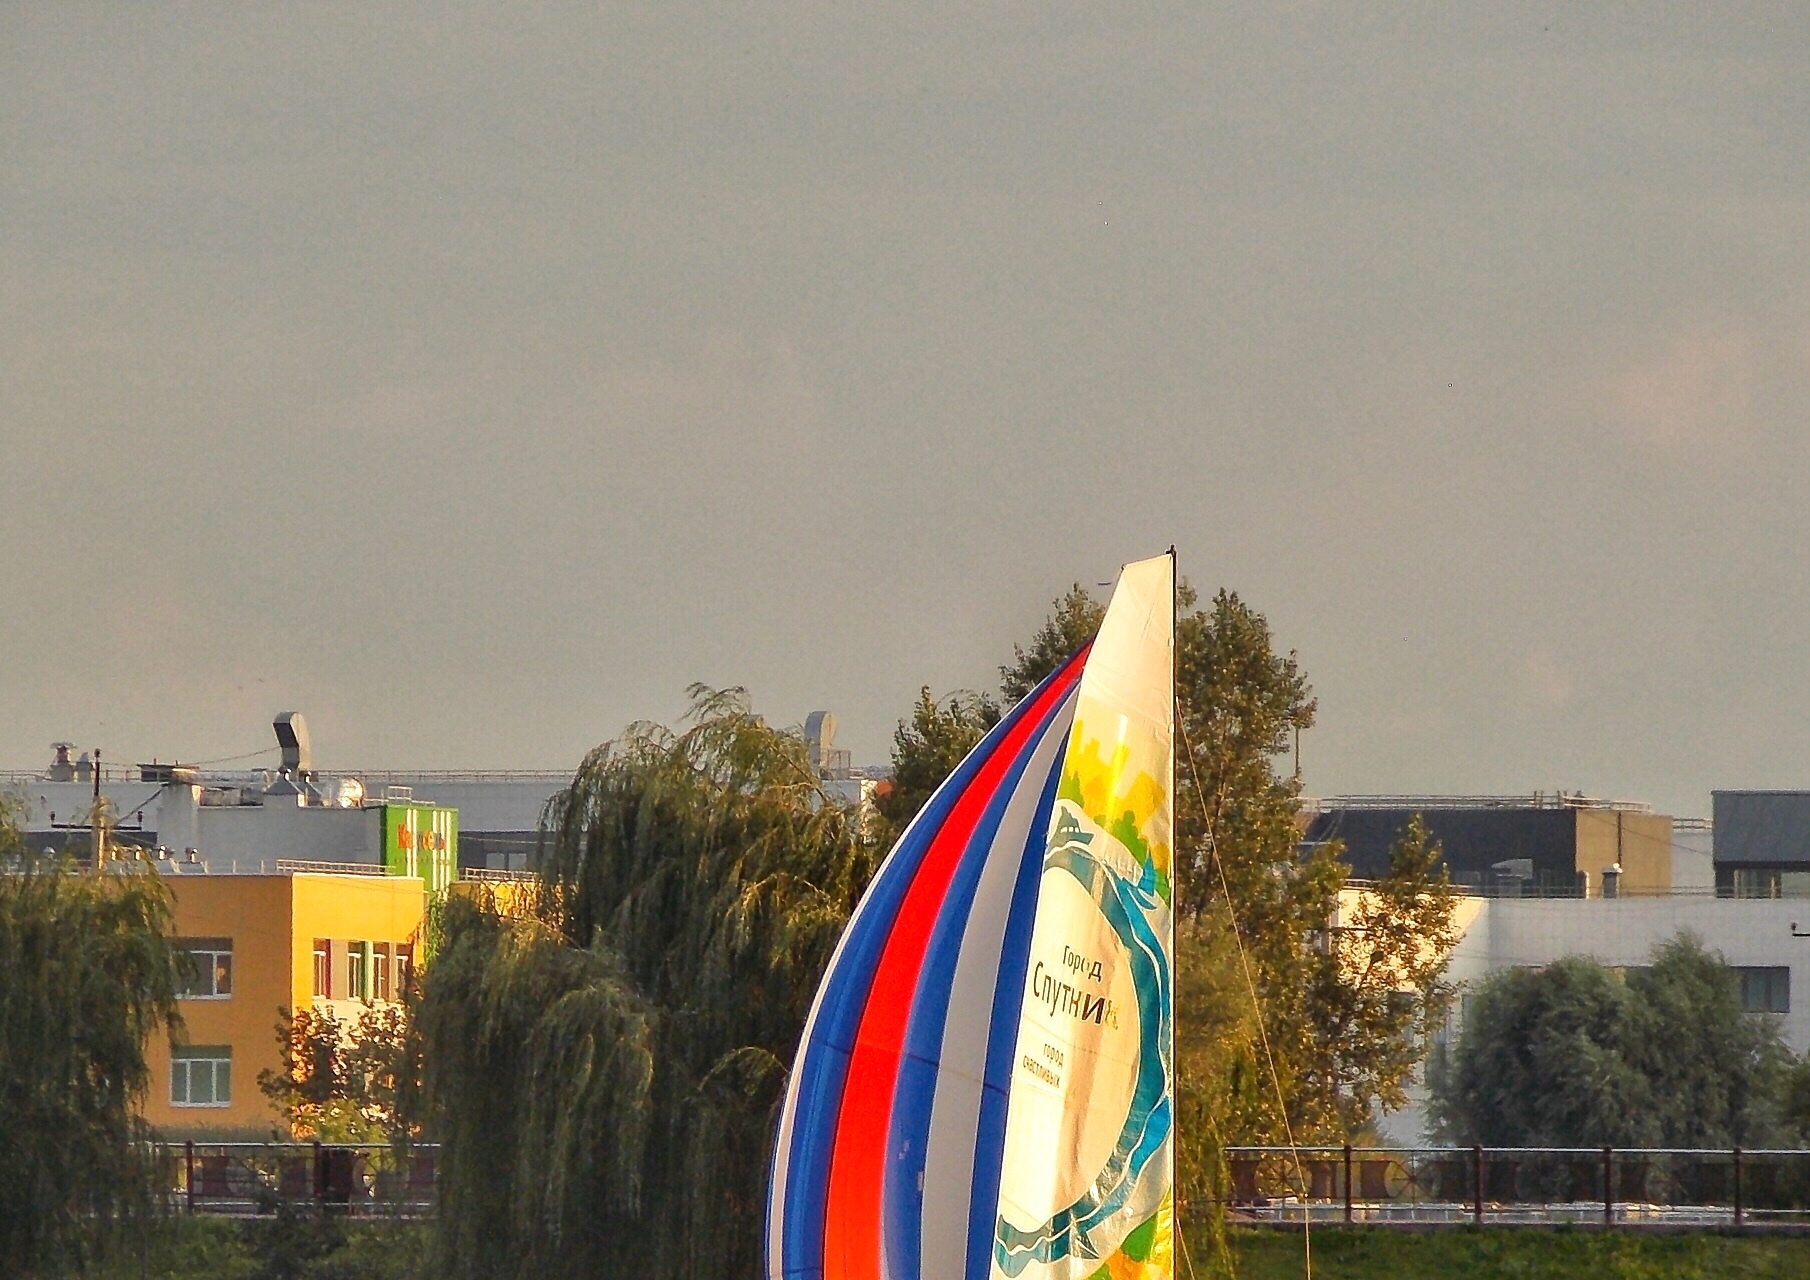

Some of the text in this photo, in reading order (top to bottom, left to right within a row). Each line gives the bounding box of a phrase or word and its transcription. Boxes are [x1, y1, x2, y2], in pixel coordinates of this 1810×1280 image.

[1062, 945, 1103, 982] Город
[1023, 1055, 1060, 1088] счастливых
[1043, 1043, 1064, 1070] город
